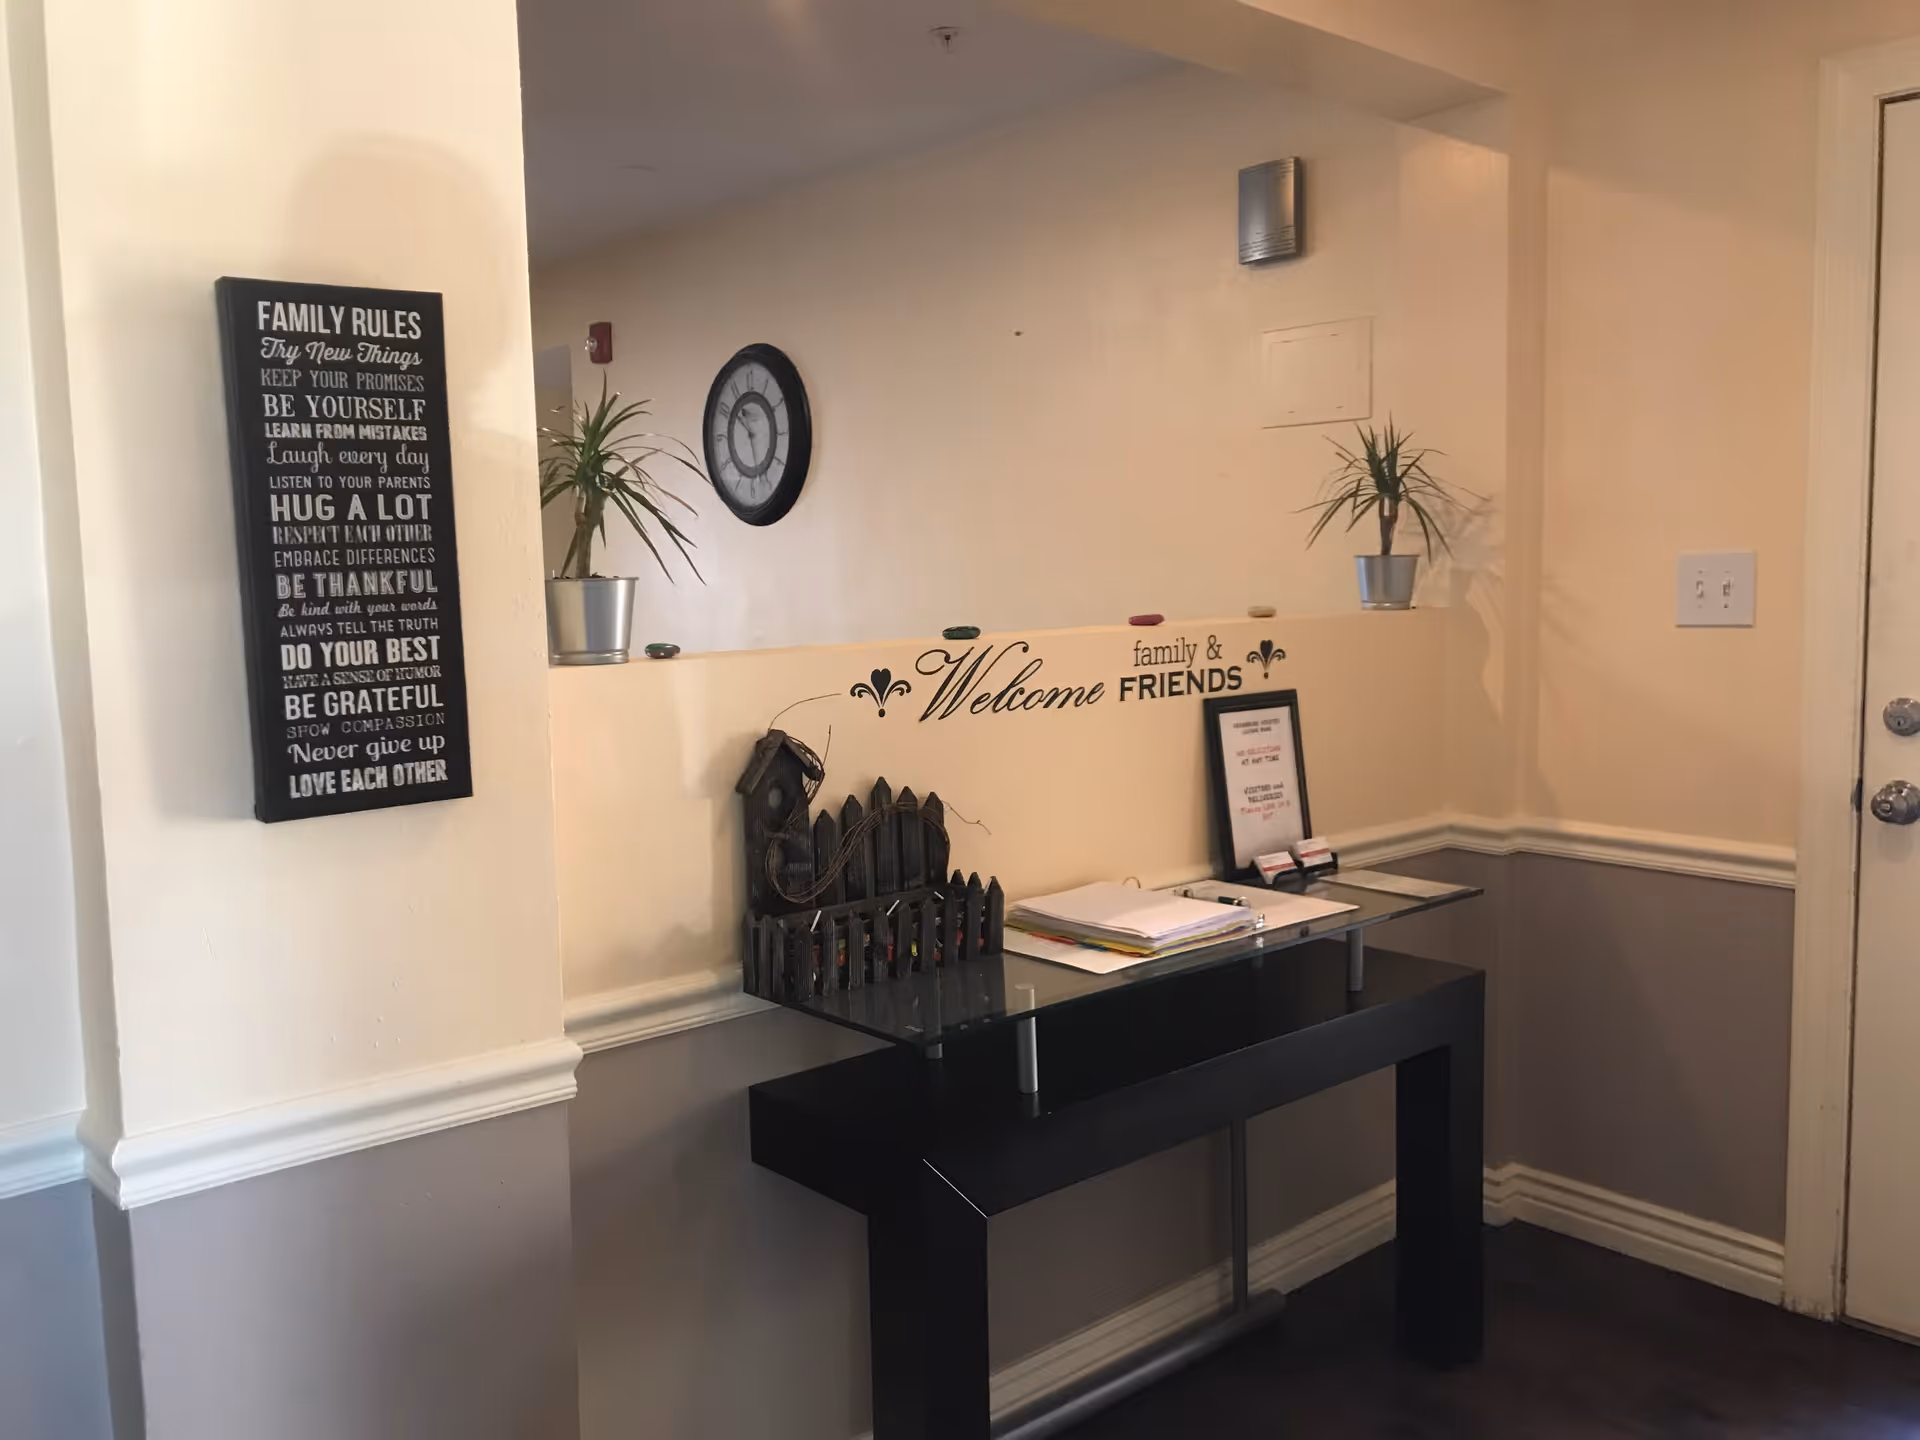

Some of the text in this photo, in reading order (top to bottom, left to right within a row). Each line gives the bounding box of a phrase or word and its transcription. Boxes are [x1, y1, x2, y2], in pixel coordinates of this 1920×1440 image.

[257, 301, 422, 339] FAMILY RULES
[261, 336, 423, 370] Try New Things
[261, 368, 425, 392] KEEP YOUR PROMISES
[262, 394, 426, 421] BE YOURSELF
[264, 422, 427, 441] LEARN FROM MISTAKES
[266, 441, 430, 474] Laugh every day
[269, 476, 431, 489] LISTEN TO YOUR PARENTS
[270, 494, 432, 522] HUG A LOT
[272, 524, 432, 544] RESPECT EACH OTHER
[274, 548, 436, 568] EMBRACE DIFFERENCES
[276, 569, 438, 599] BE THANKFUL
[278, 597, 438, 618] Be kind with your words
[280, 617, 438, 638] ALWAYS TELL THE TRUTH
[281, 635, 441, 671] DO YOUR BEST
[1133, 634, 1224, 668] family &
[282, 665, 442, 689] HAVE A SENSE OF HUMOR
[915, 641, 1105, 723] Welcome
[1119, 666, 1243, 702] FRIENDS
[284, 683, 444, 721] BE GRATEFUL
[286, 713, 445, 739] SHOW COMPASSION
[287, 735, 445, 764] Never give up
[289, 759, 448, 799] LOVE EACH OTHER
